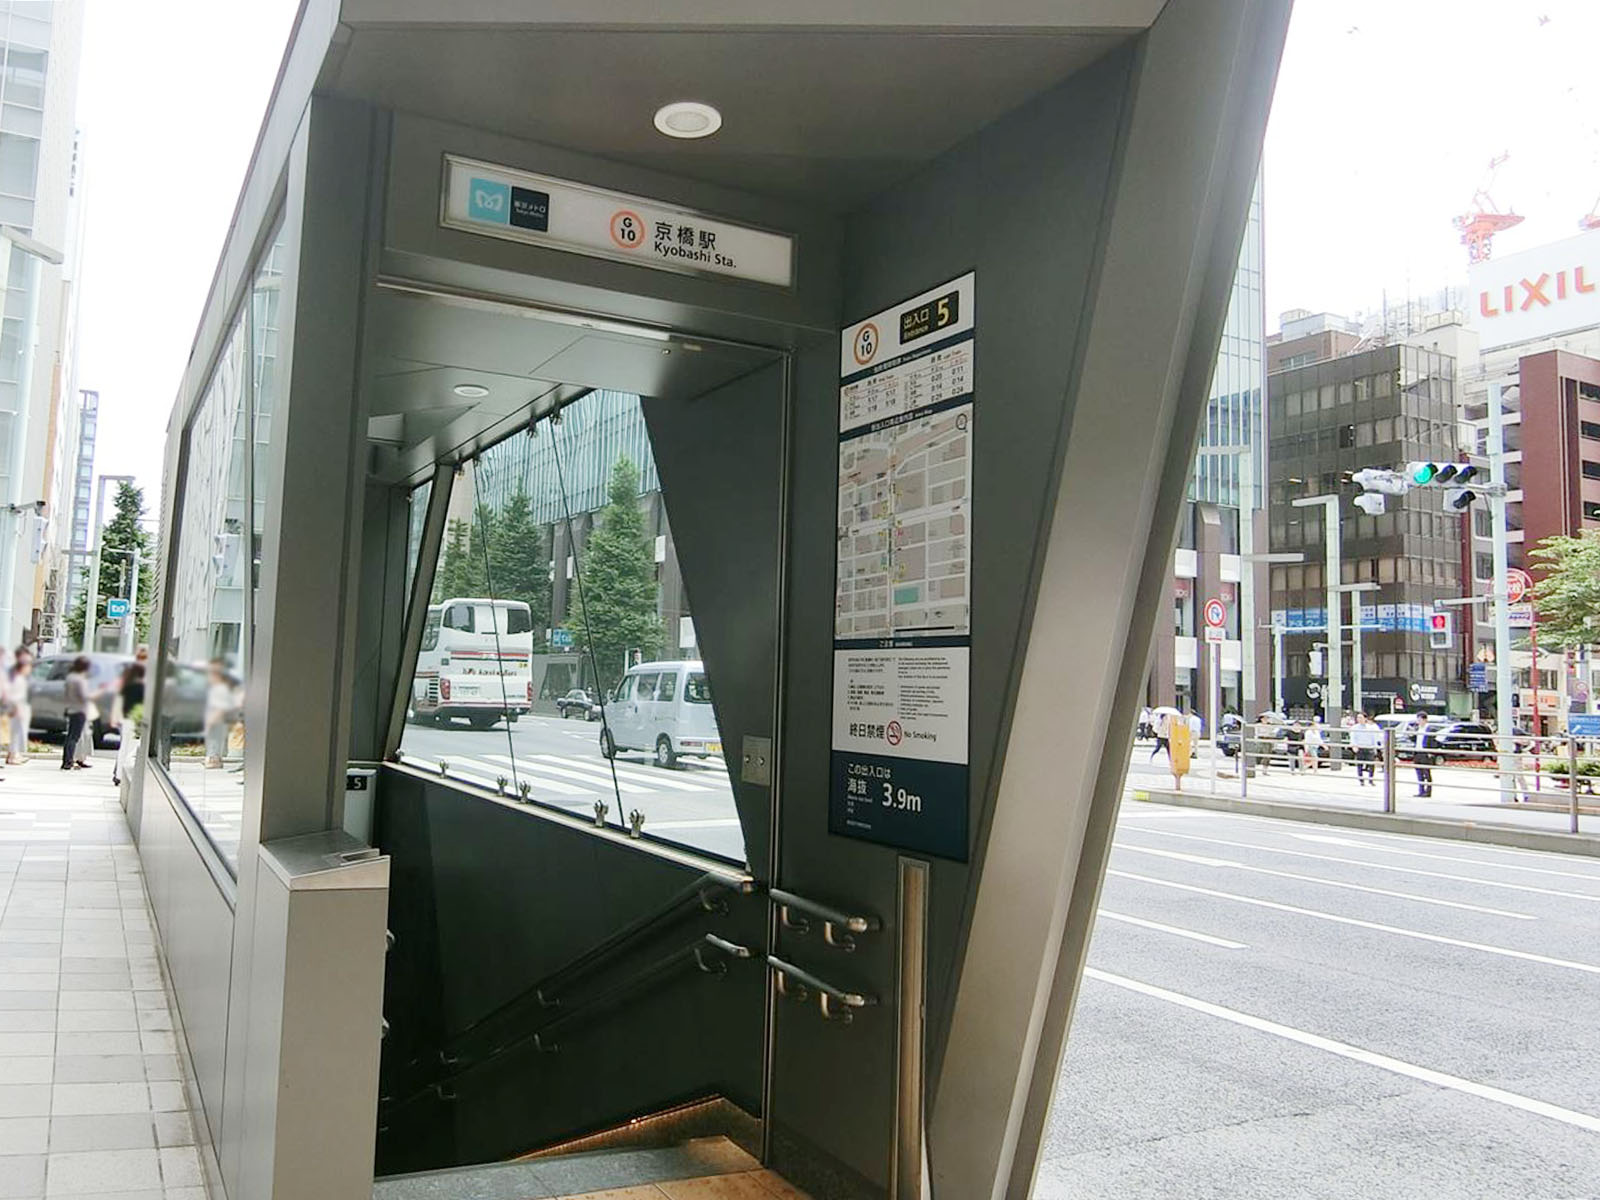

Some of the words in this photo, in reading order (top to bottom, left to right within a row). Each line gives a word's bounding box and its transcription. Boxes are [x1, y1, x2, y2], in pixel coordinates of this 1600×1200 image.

[623, 217, 632, 228] G
[621, 228, 636, 241] 10
[655, 221, 716, 250] 京橋駅
[654, 241, 711, 263] Kyobashi
[714, 253, 737, 268] Sta.
[1480, 266, 1595, 317] LIXIL
[937, 298, 949, 326] 5
[862, 330, 870, 342] G
[861, 342, 873, 357] 10
[849, 723, 885, 740] 終日禁煙
[904, 731, 912, 739] No
[912, 728, 937, 743] Smoking
[847, 763, 891, 779] この出入口は
[882, 782, 921, 812] 3.9m
